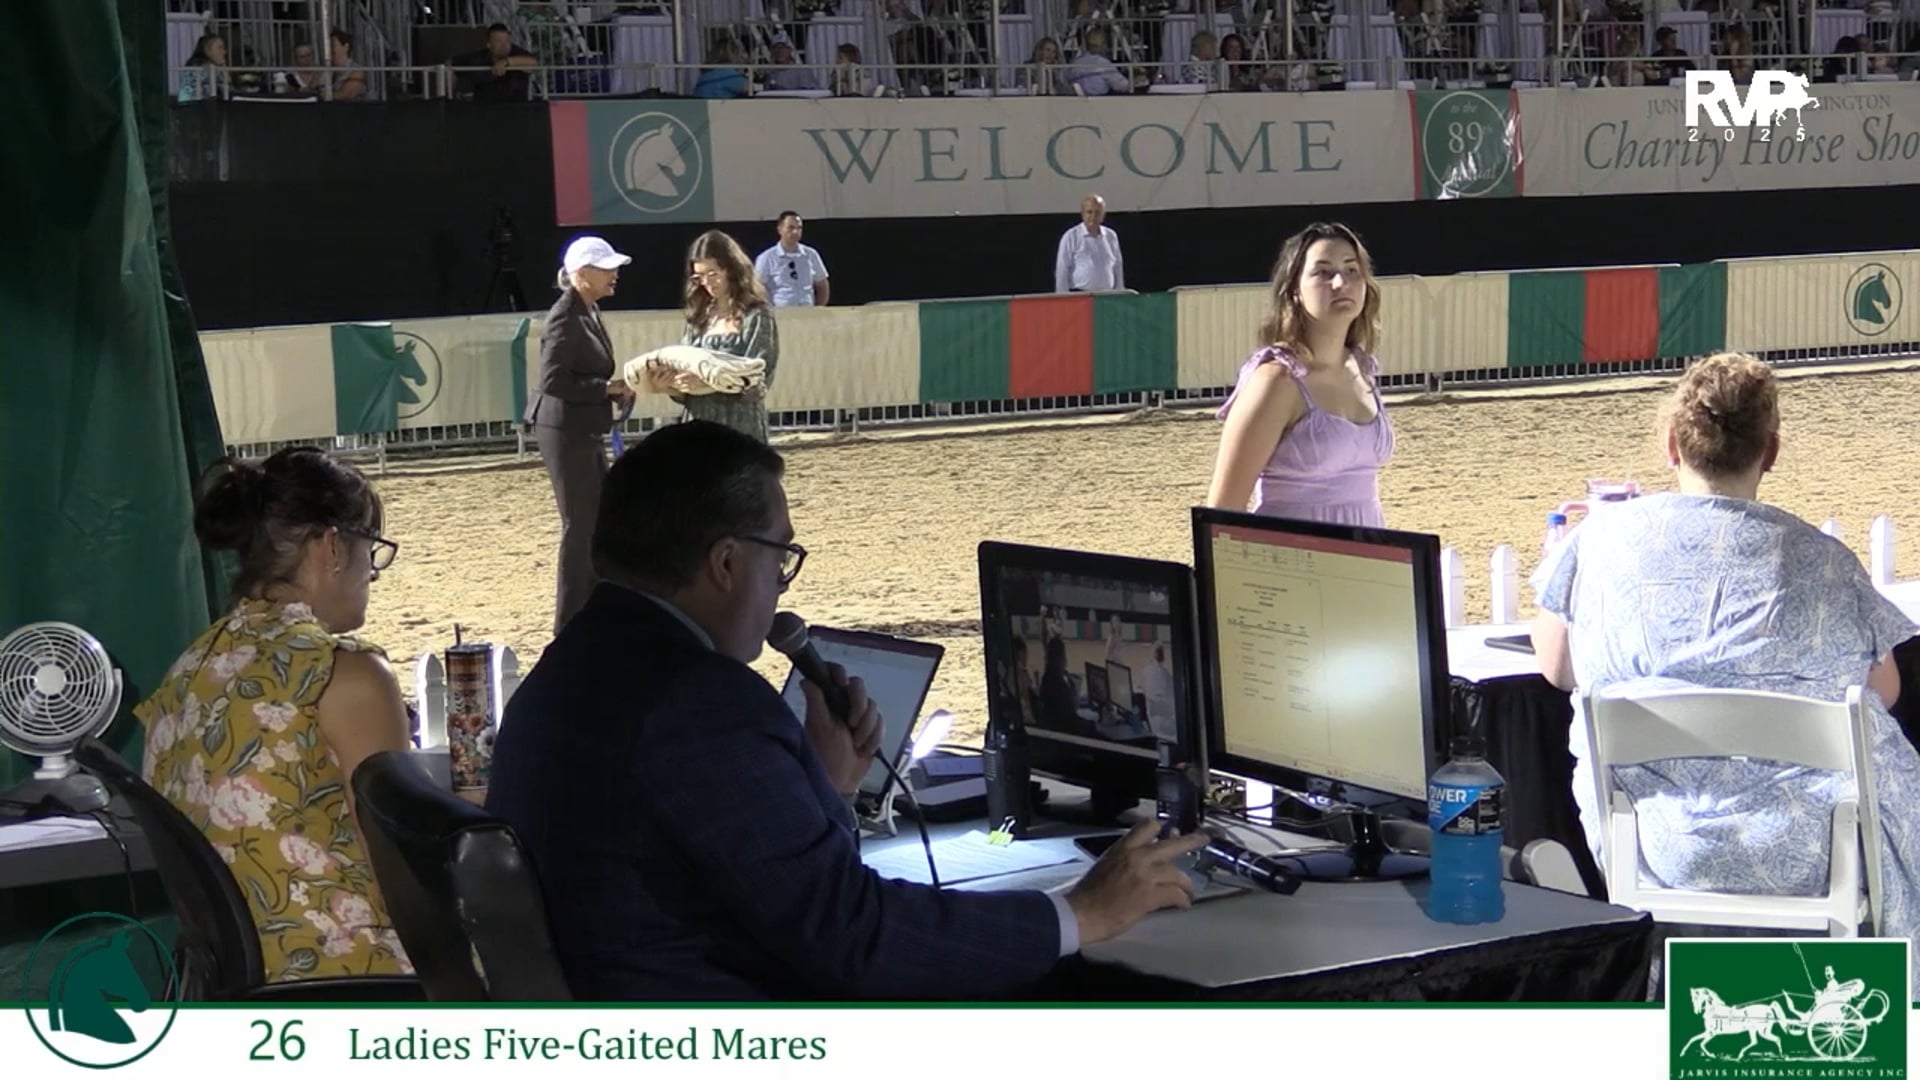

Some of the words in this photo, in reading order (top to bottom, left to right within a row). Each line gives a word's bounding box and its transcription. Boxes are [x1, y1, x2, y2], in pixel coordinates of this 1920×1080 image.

[1646, 97, 1696, 119] JUNI
[1798, 94, 1891, 112] INGTON
[801, 119, 1343, 184] WELCOME
[1584, 119, 1727, 183] Charity
[1738, 118, 1845, 166] Horse
[1856, 112, 1920, 162] Sho
[1429, 785, 1467, 803] OWER
